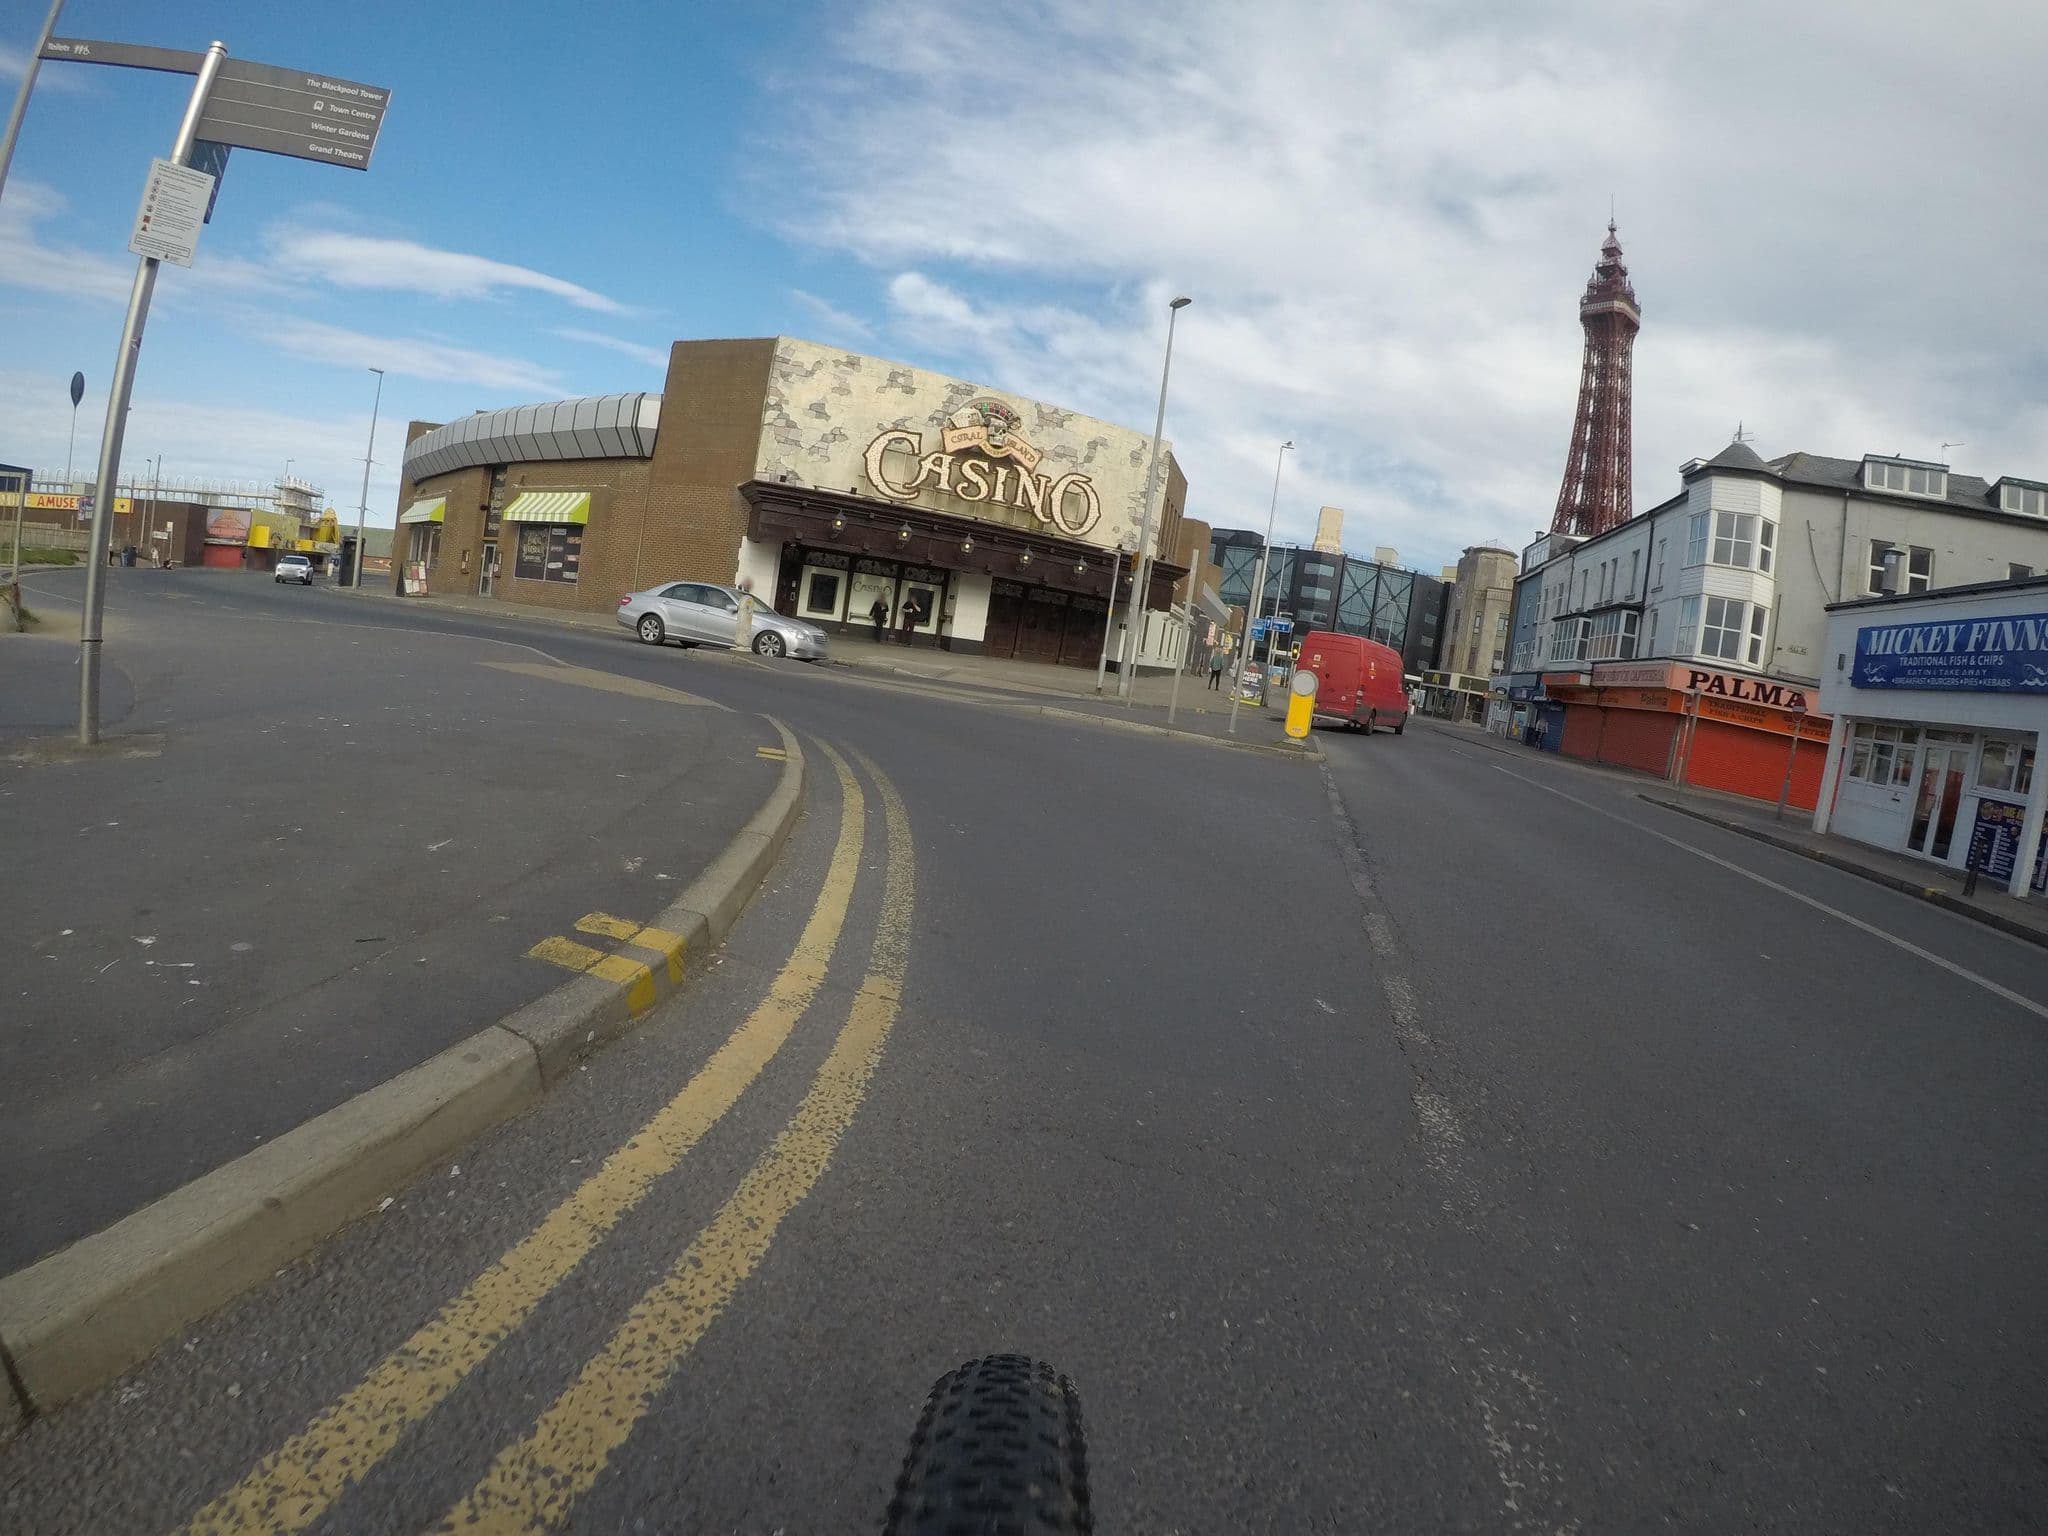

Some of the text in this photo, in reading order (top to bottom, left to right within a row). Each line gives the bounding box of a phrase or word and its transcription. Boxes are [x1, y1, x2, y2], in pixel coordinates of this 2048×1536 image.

[307, 79, 383, 101] The Blackpool Tower
[329, 104, 377, 121] Town Centre
[311, 122, 370, 141] Winter Gardens
[309, 143, 364, 161] Grand Theatre
[951, 431, 983, 444] CORAL
[1007, 437, 1036, 463] ISLAND
[863, 429, 1101, 536] CASINO
[1865, 624, 1966, 656] MICKEY
[1900, 654, 2004, 667] TRADITIONAL FISH & CHIPS
[1938, 668, 1960, 677] TAKE
[1961, 668, 1988, 677] AWAY
[1686, 670, 1806, 710] PALMA
[1983, 679, 2012, 688] KEBABS
